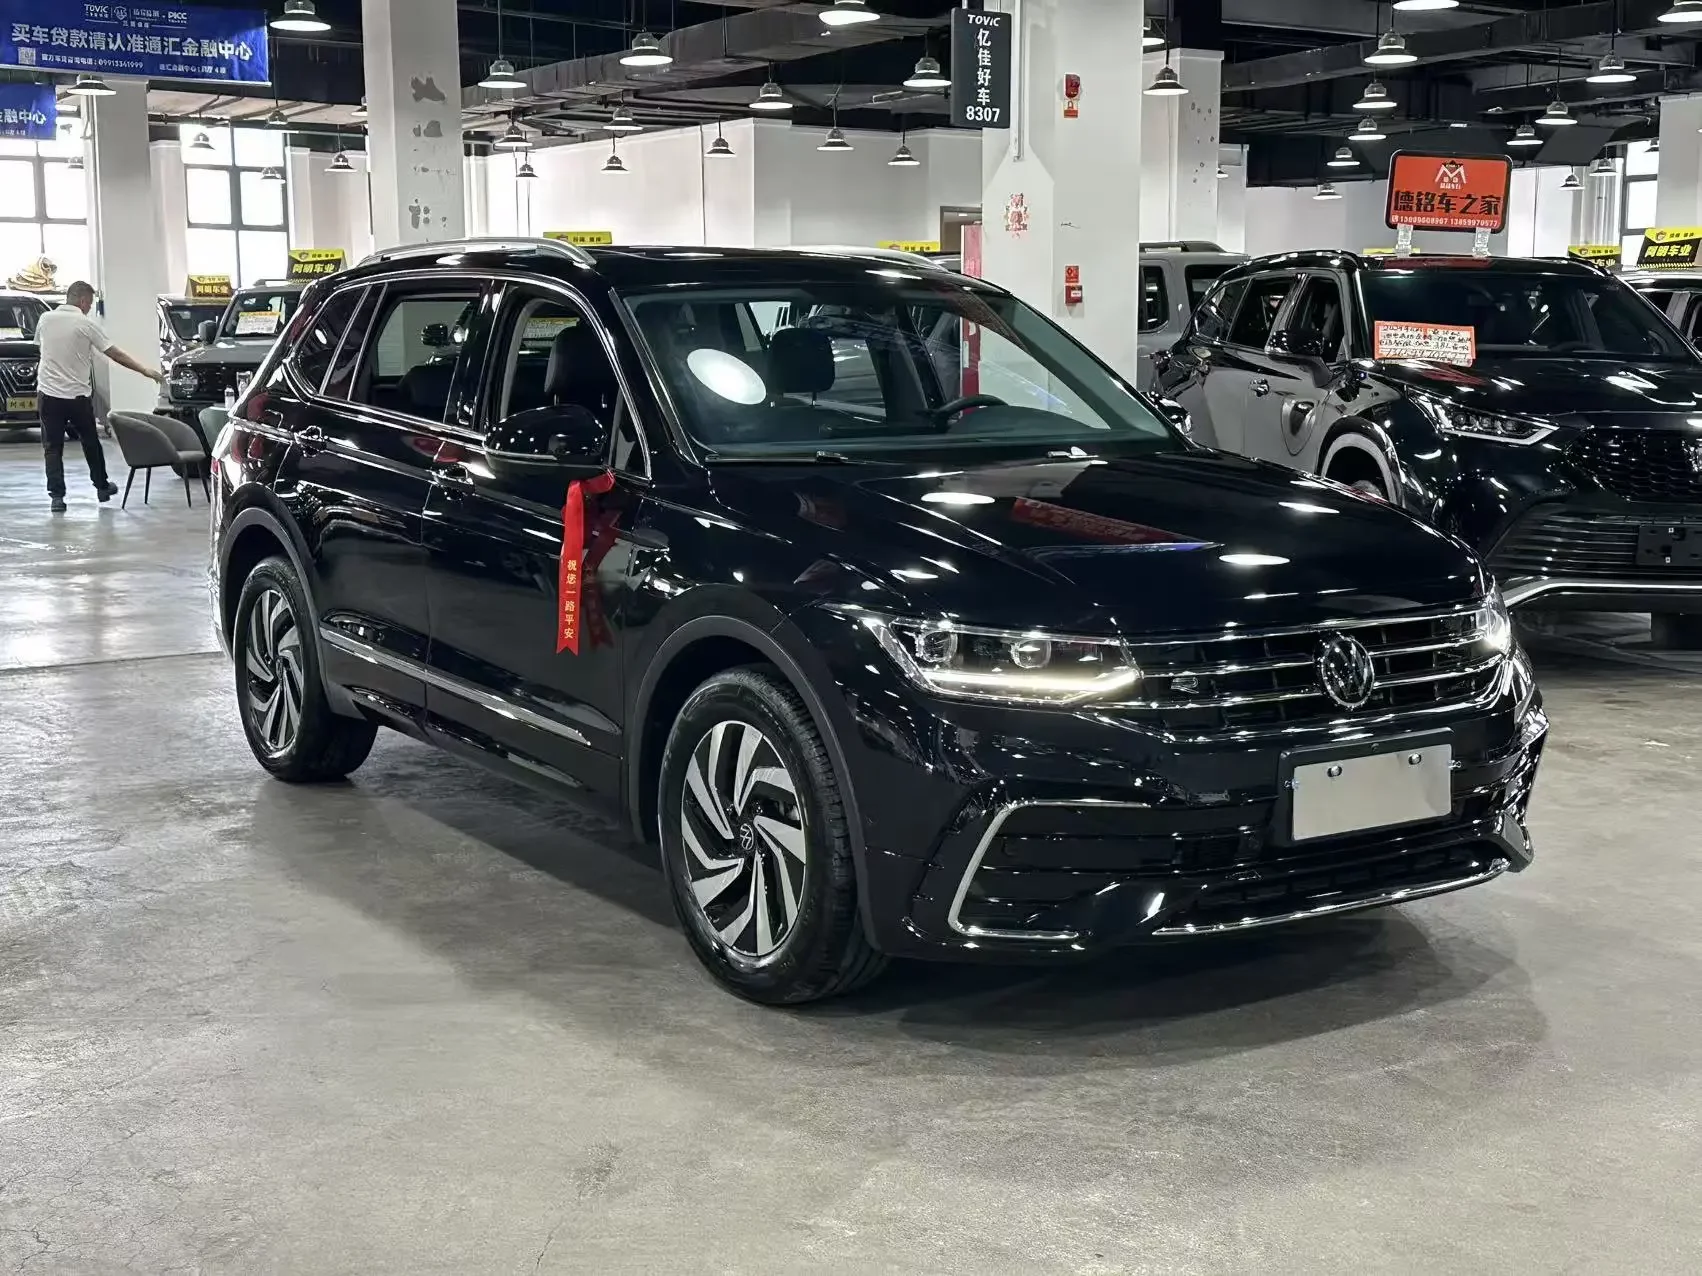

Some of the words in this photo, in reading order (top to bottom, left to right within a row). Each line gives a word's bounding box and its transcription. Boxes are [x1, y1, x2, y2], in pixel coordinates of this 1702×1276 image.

[168, 12, 187, 20] PICC
[967, 14, 1001, 27] TOVIC
[11, 23, 253, 61] 买车贷款请认准通汇金融中心
[977, 28, 992, 105] 亿佳好车
[965, 105, 1000, 122] 8307
[1394, 190, 1501, 215] 德铭车之家
[1644, 244, 1693, 258] 阿明车业
[564, 560, 577, 639] 祝您一路平安
